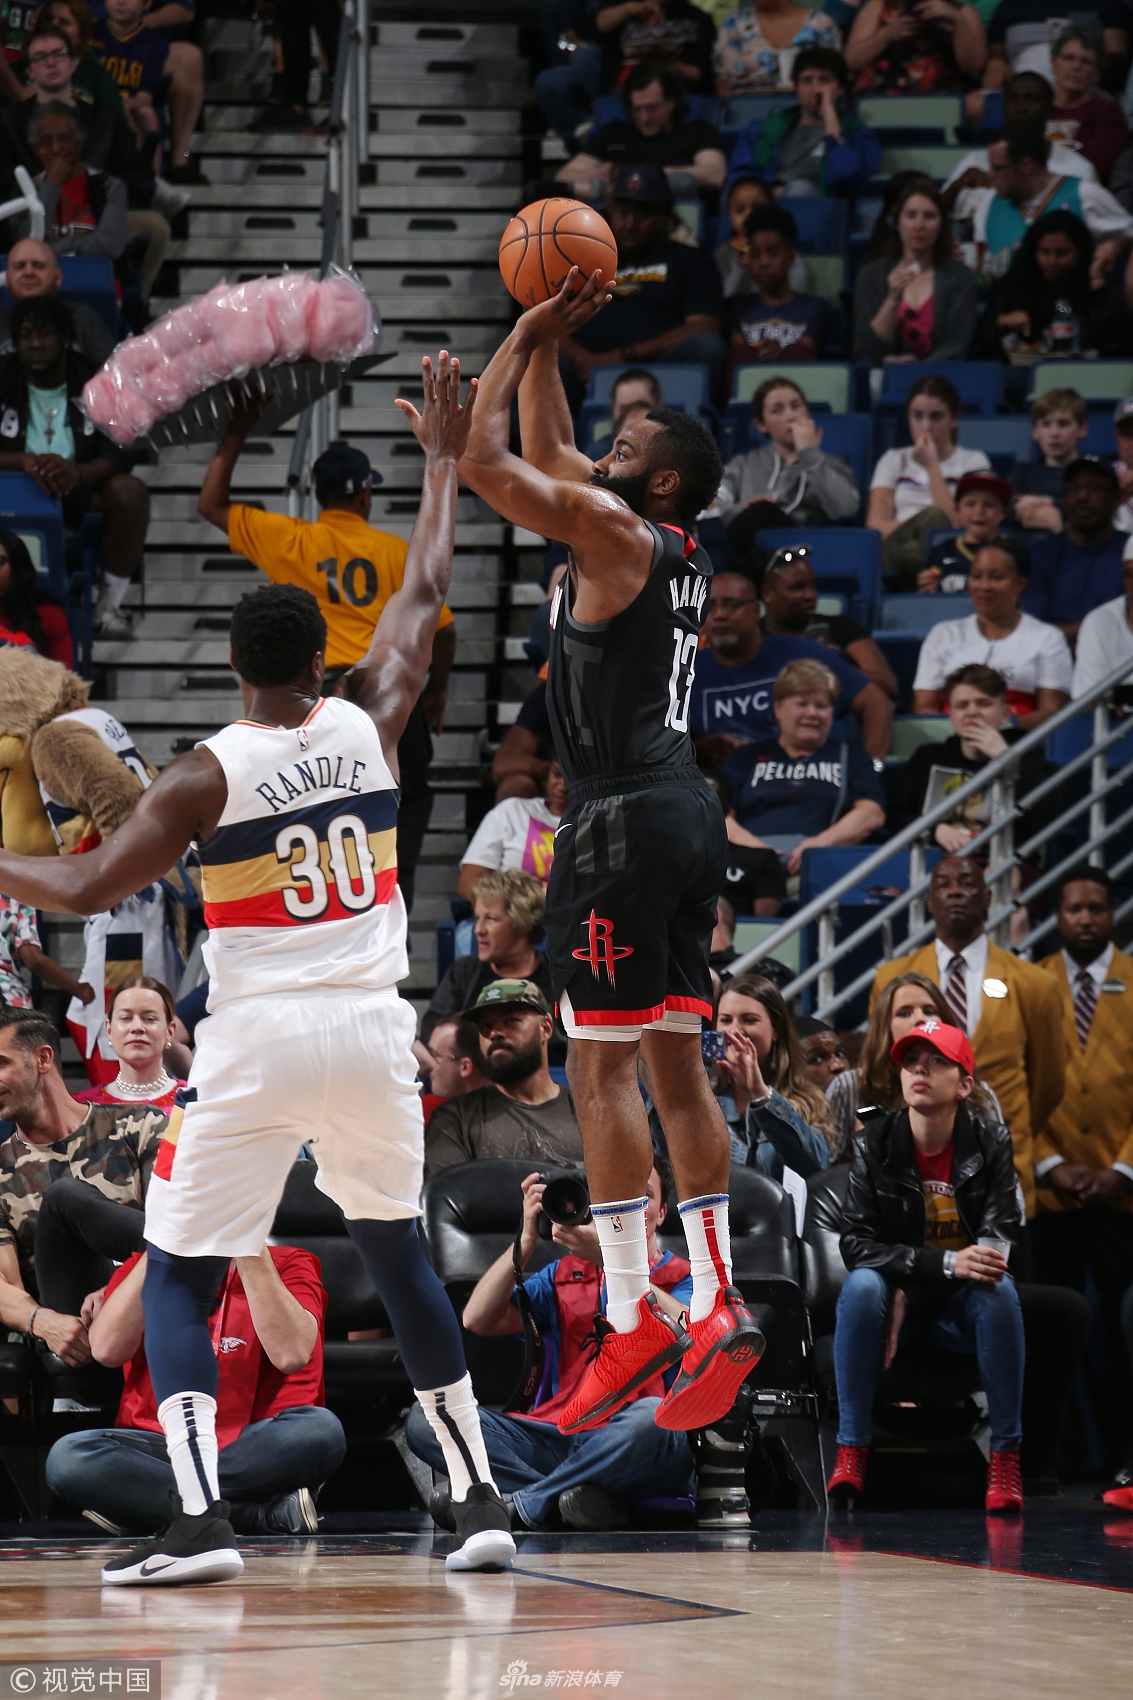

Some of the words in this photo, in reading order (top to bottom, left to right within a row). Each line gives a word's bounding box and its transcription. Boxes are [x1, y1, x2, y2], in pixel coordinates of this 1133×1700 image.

[316, 557, 379, 608] 10
[664, 627, 698, 733] 13
[714, 690, 769, 719] NYC
[255, 756, 366, 813] RANDLE
[751, 761, 842, 788] PELICANS
[275, 813, 376, 922] 30
